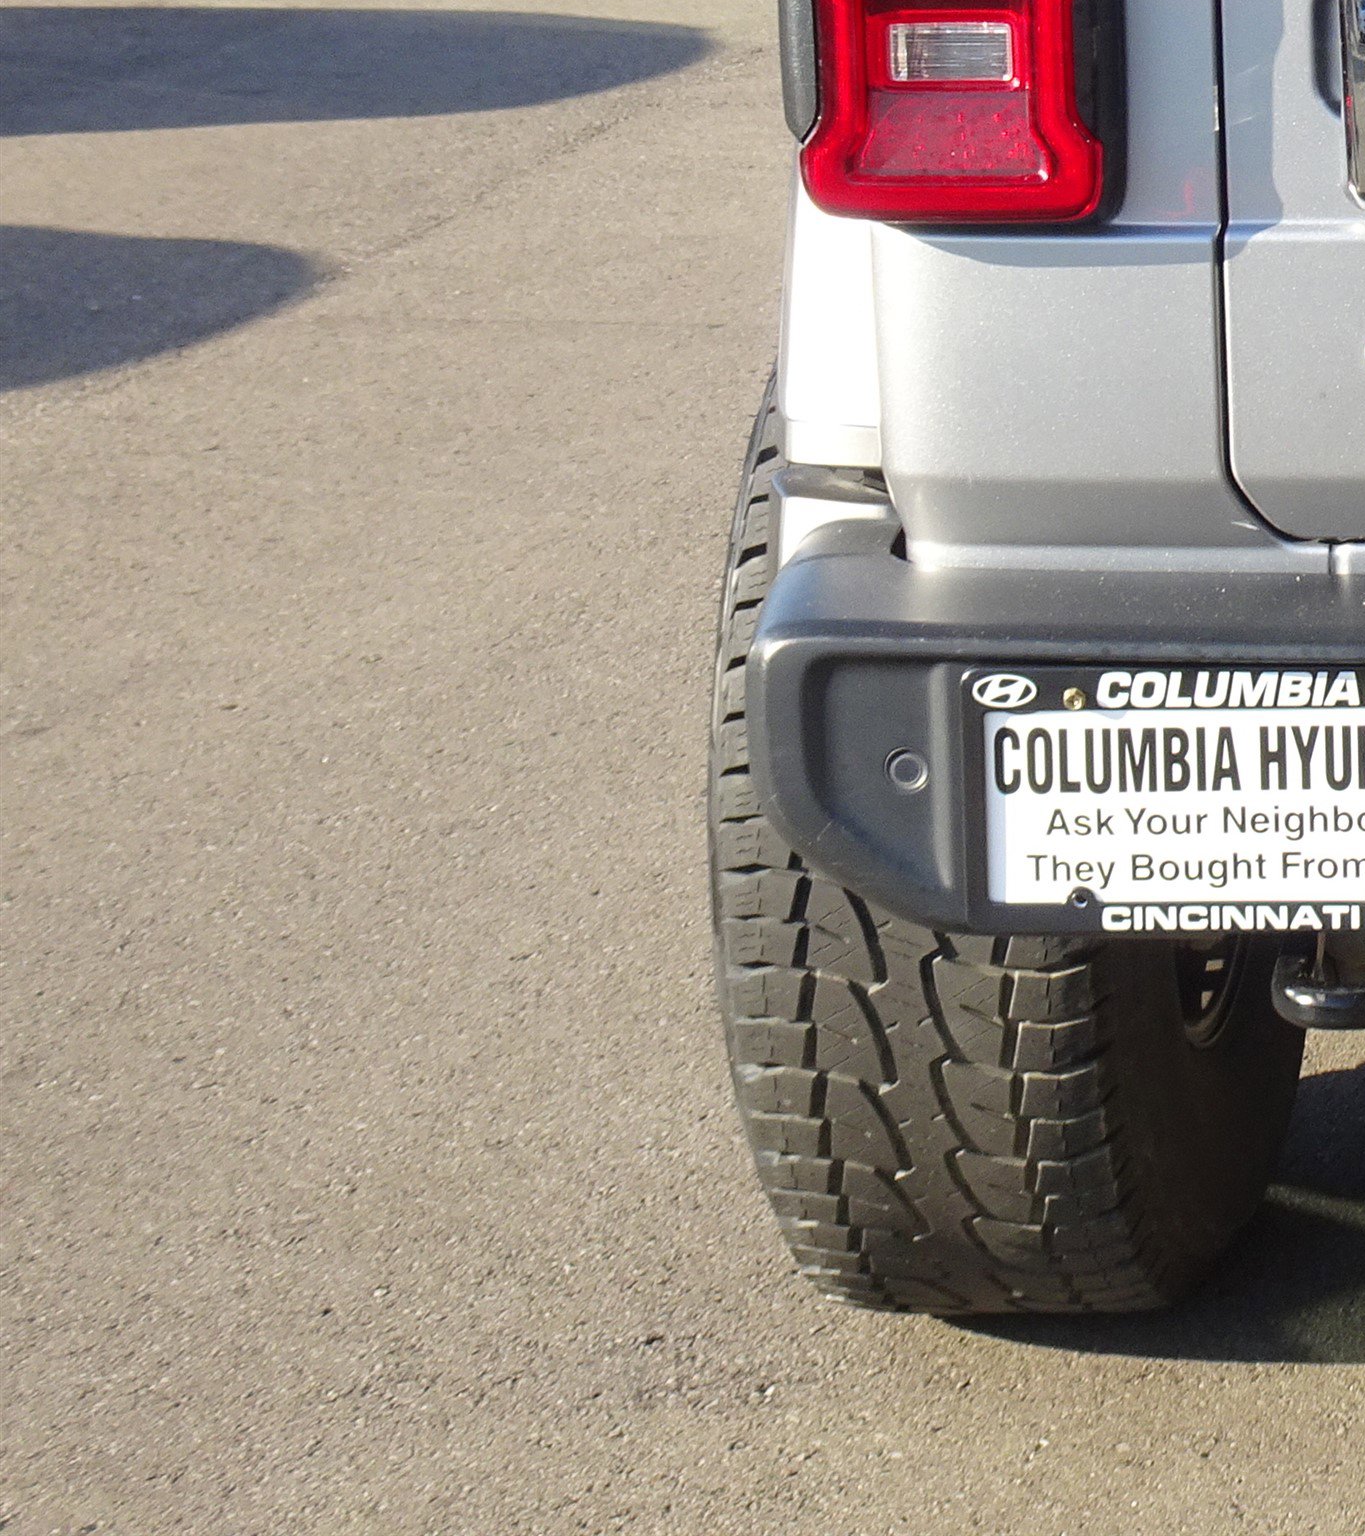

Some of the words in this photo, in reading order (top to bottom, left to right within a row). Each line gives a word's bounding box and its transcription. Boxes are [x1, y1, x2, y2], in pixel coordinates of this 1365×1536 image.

[1096, 670, 1361, 709] COLUMBIA
[992, 725, 1242, 795] COLUMBIA
[1045, 807, 1115, 836] Ask
[1123, 807, 1209, 835] Your
[1026, 853, 1116, 890] They
[1130, 851, 1268, 888] Bought
[1100, 903, 1362, 932] CINCINNATI
